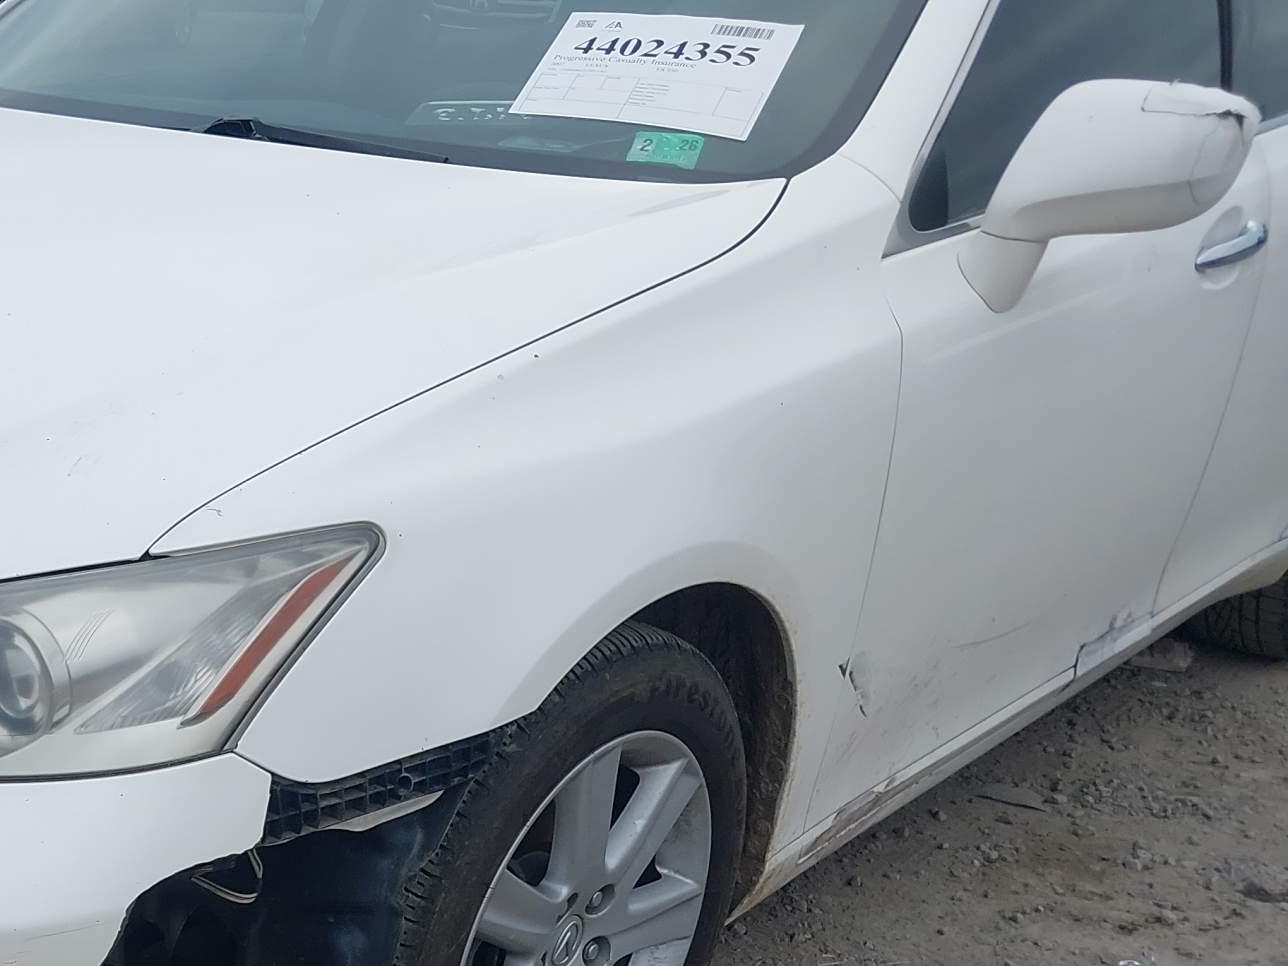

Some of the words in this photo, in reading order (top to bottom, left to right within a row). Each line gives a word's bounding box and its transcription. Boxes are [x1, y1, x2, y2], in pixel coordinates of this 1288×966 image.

[573, 36, 761, 67] 44024355
[553, 54, 606, 64] Progressive
[608, 56, 647, 65] Casualty
[651, 59, 697, 69] Insurance
[640, 138, 653, 152] 2
[679, 139, 699, 152] 26
